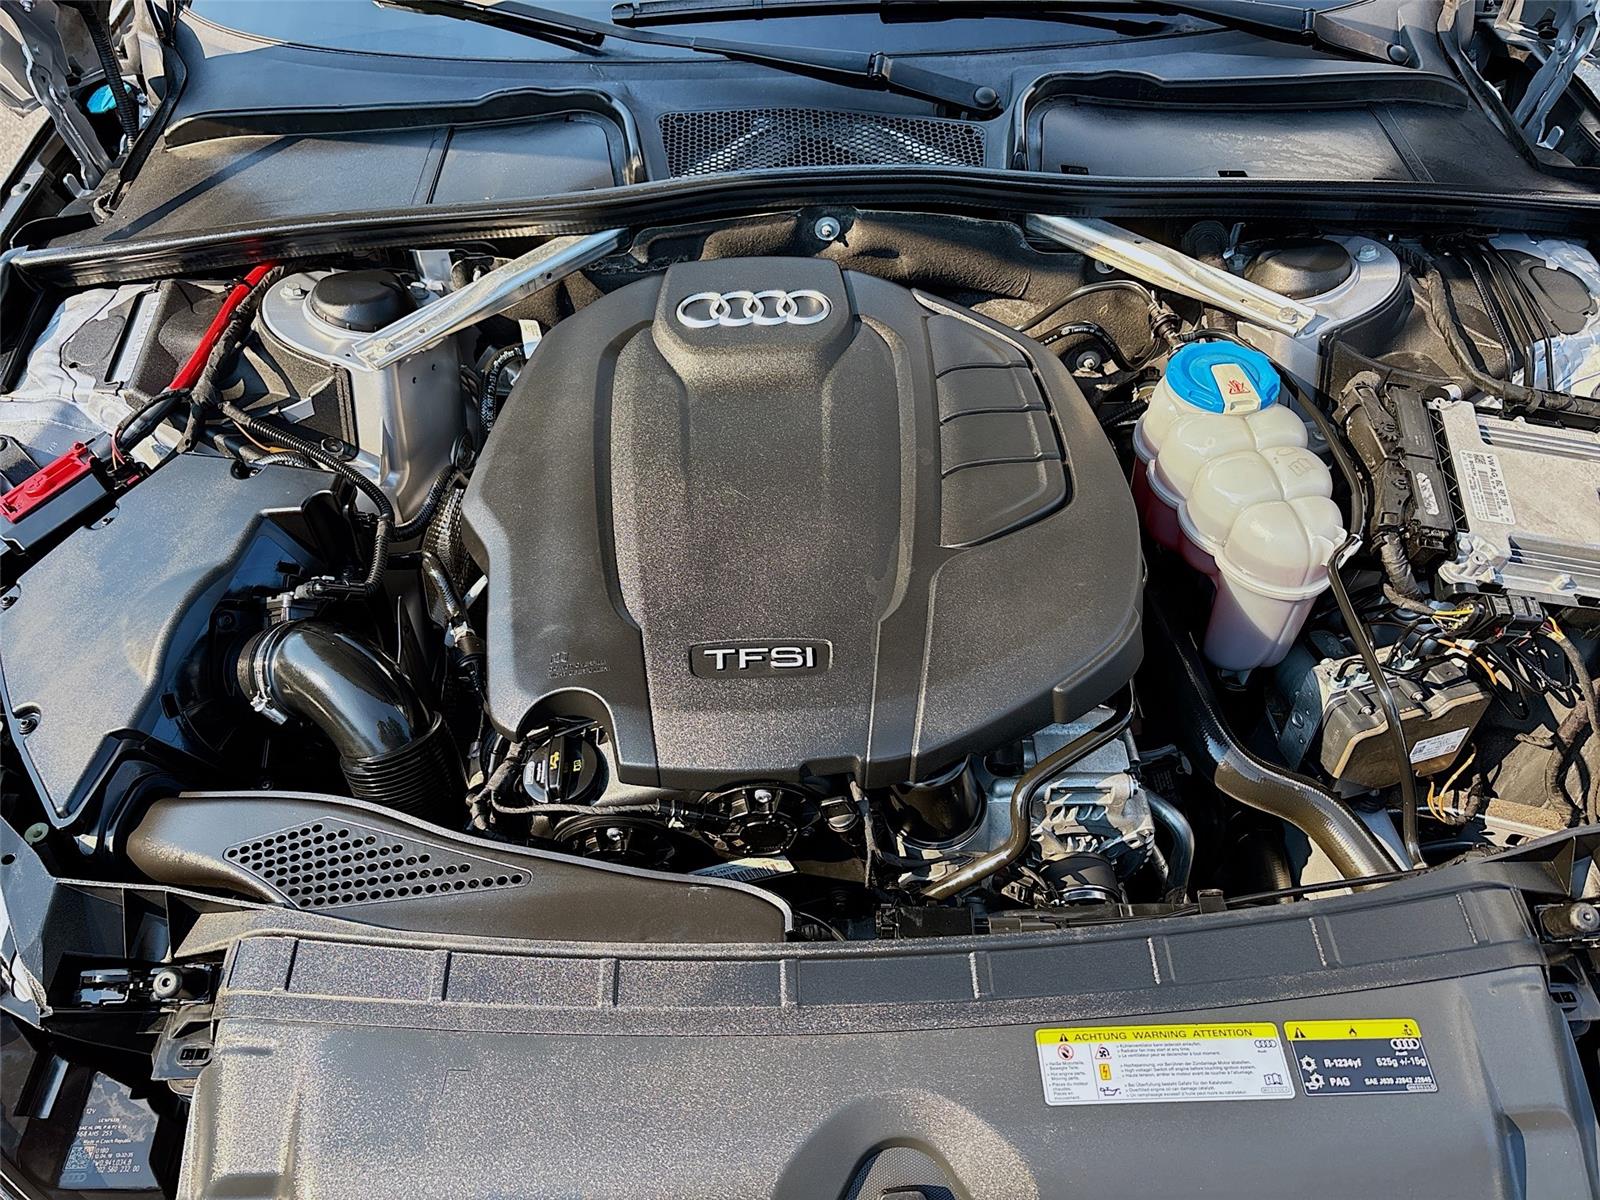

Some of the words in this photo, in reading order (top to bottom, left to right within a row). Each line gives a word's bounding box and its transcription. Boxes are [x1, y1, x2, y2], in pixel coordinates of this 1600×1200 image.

[704, 646, 814, 670] TFSI
[1074, 1031, 1127, 1041] ACHTUNG
[1133, 1030, 1187, 1039] WARNING
[1193, 1029, 1253, 1037] ATTENTION
[1329, 1077, 1351, 1087] PAG
